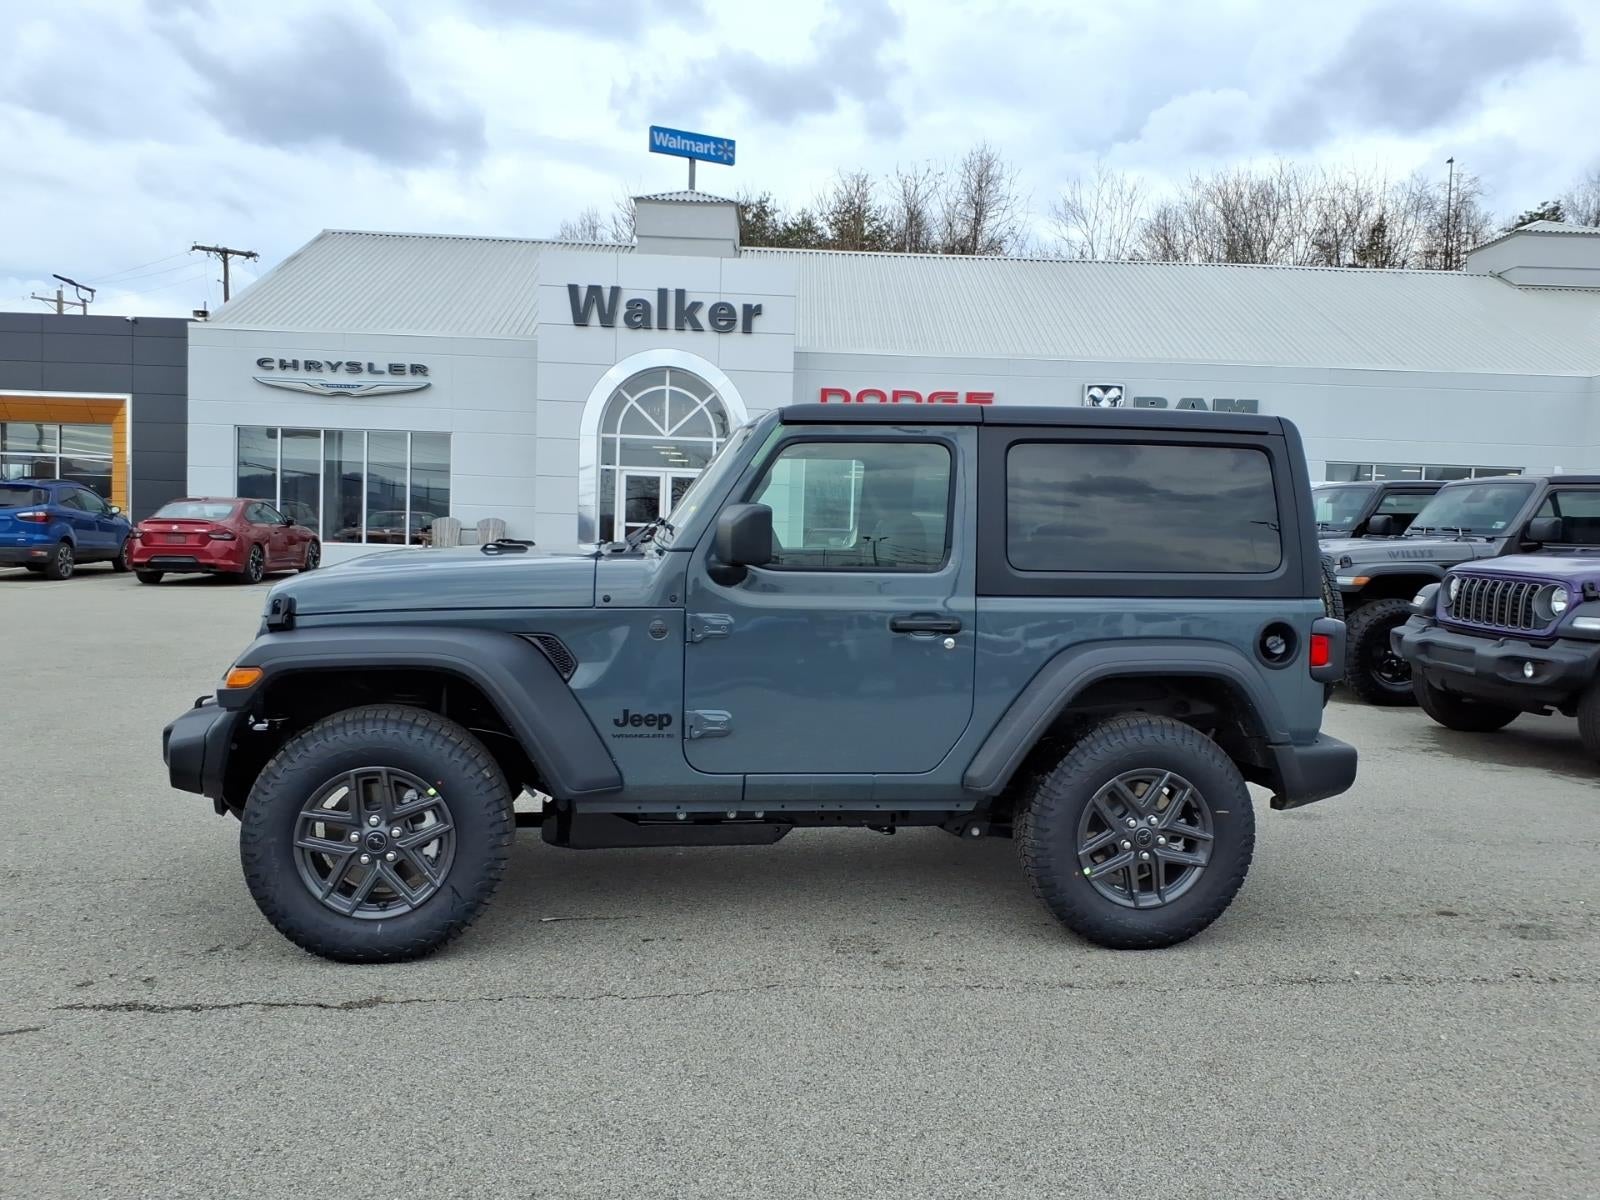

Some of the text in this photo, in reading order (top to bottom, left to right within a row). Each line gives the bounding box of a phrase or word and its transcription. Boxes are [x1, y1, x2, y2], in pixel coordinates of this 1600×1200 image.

[653, 131, 716, 156] Walmart
[567, 283, 763, 334] Walker
[256, 357, 429, 376] CHRYSLER
[820, 387, 994, 404] DODGE
[1386, 548, 1435, 559] WILLYS
[613, 708, 673, 730] Jeep
